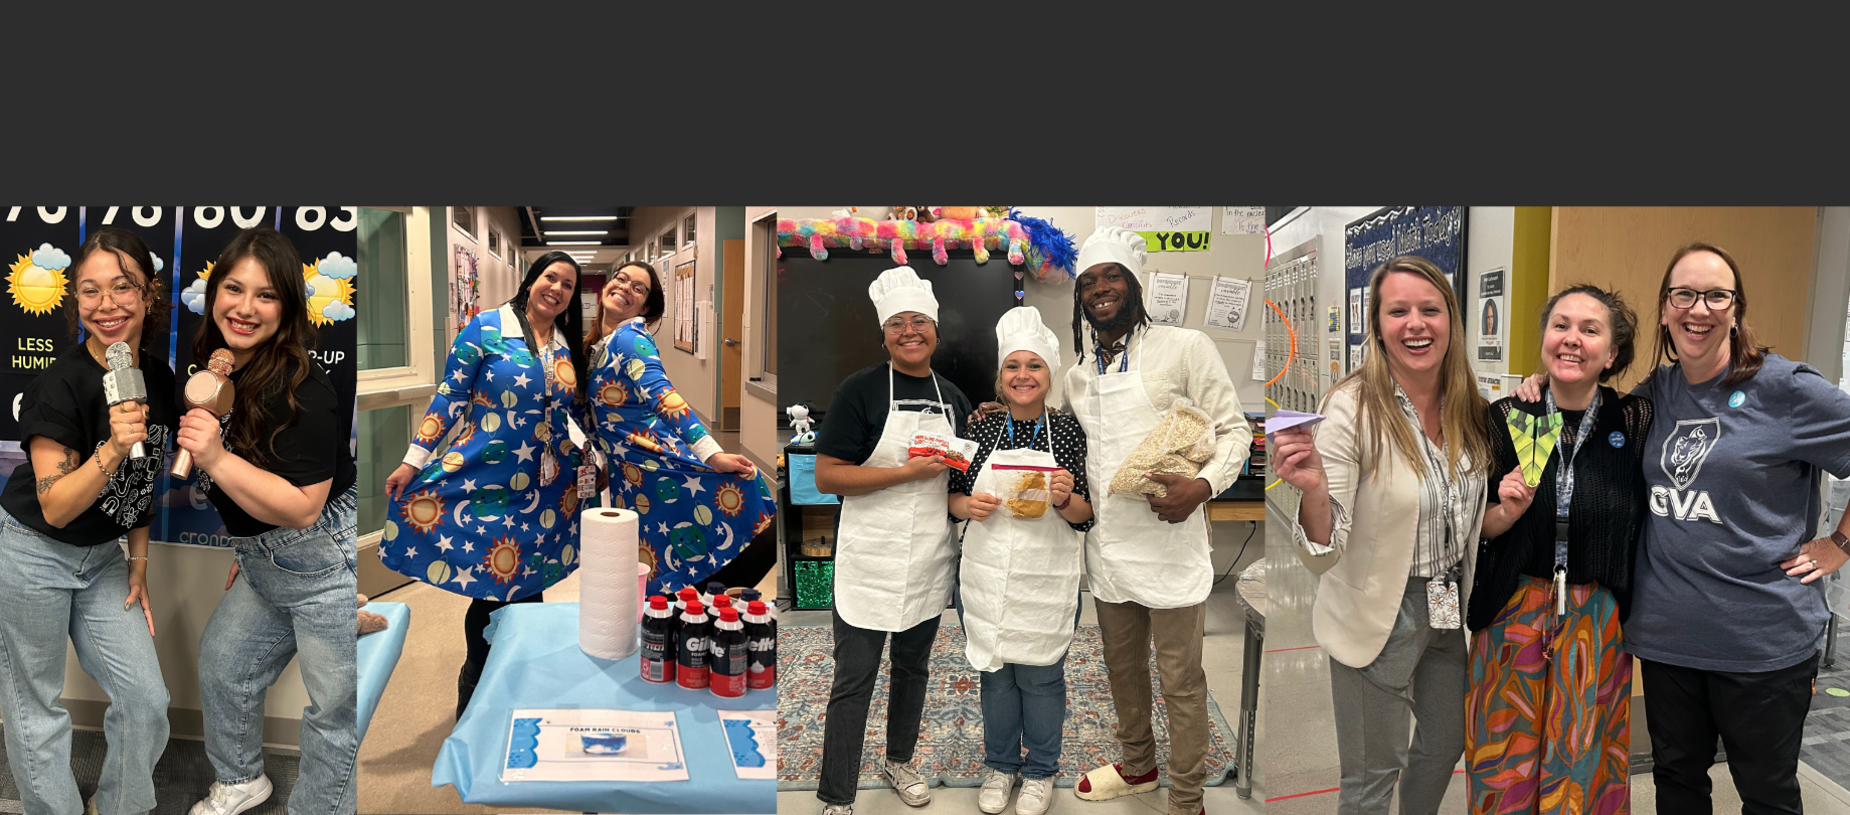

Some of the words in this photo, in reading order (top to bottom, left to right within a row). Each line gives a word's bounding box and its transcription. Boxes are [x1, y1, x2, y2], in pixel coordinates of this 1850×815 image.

[1156, 231, 1210, 251] YOU!
[18, 337, 54, 352] LESS
[1650, 484, 1724, 525] GVA
